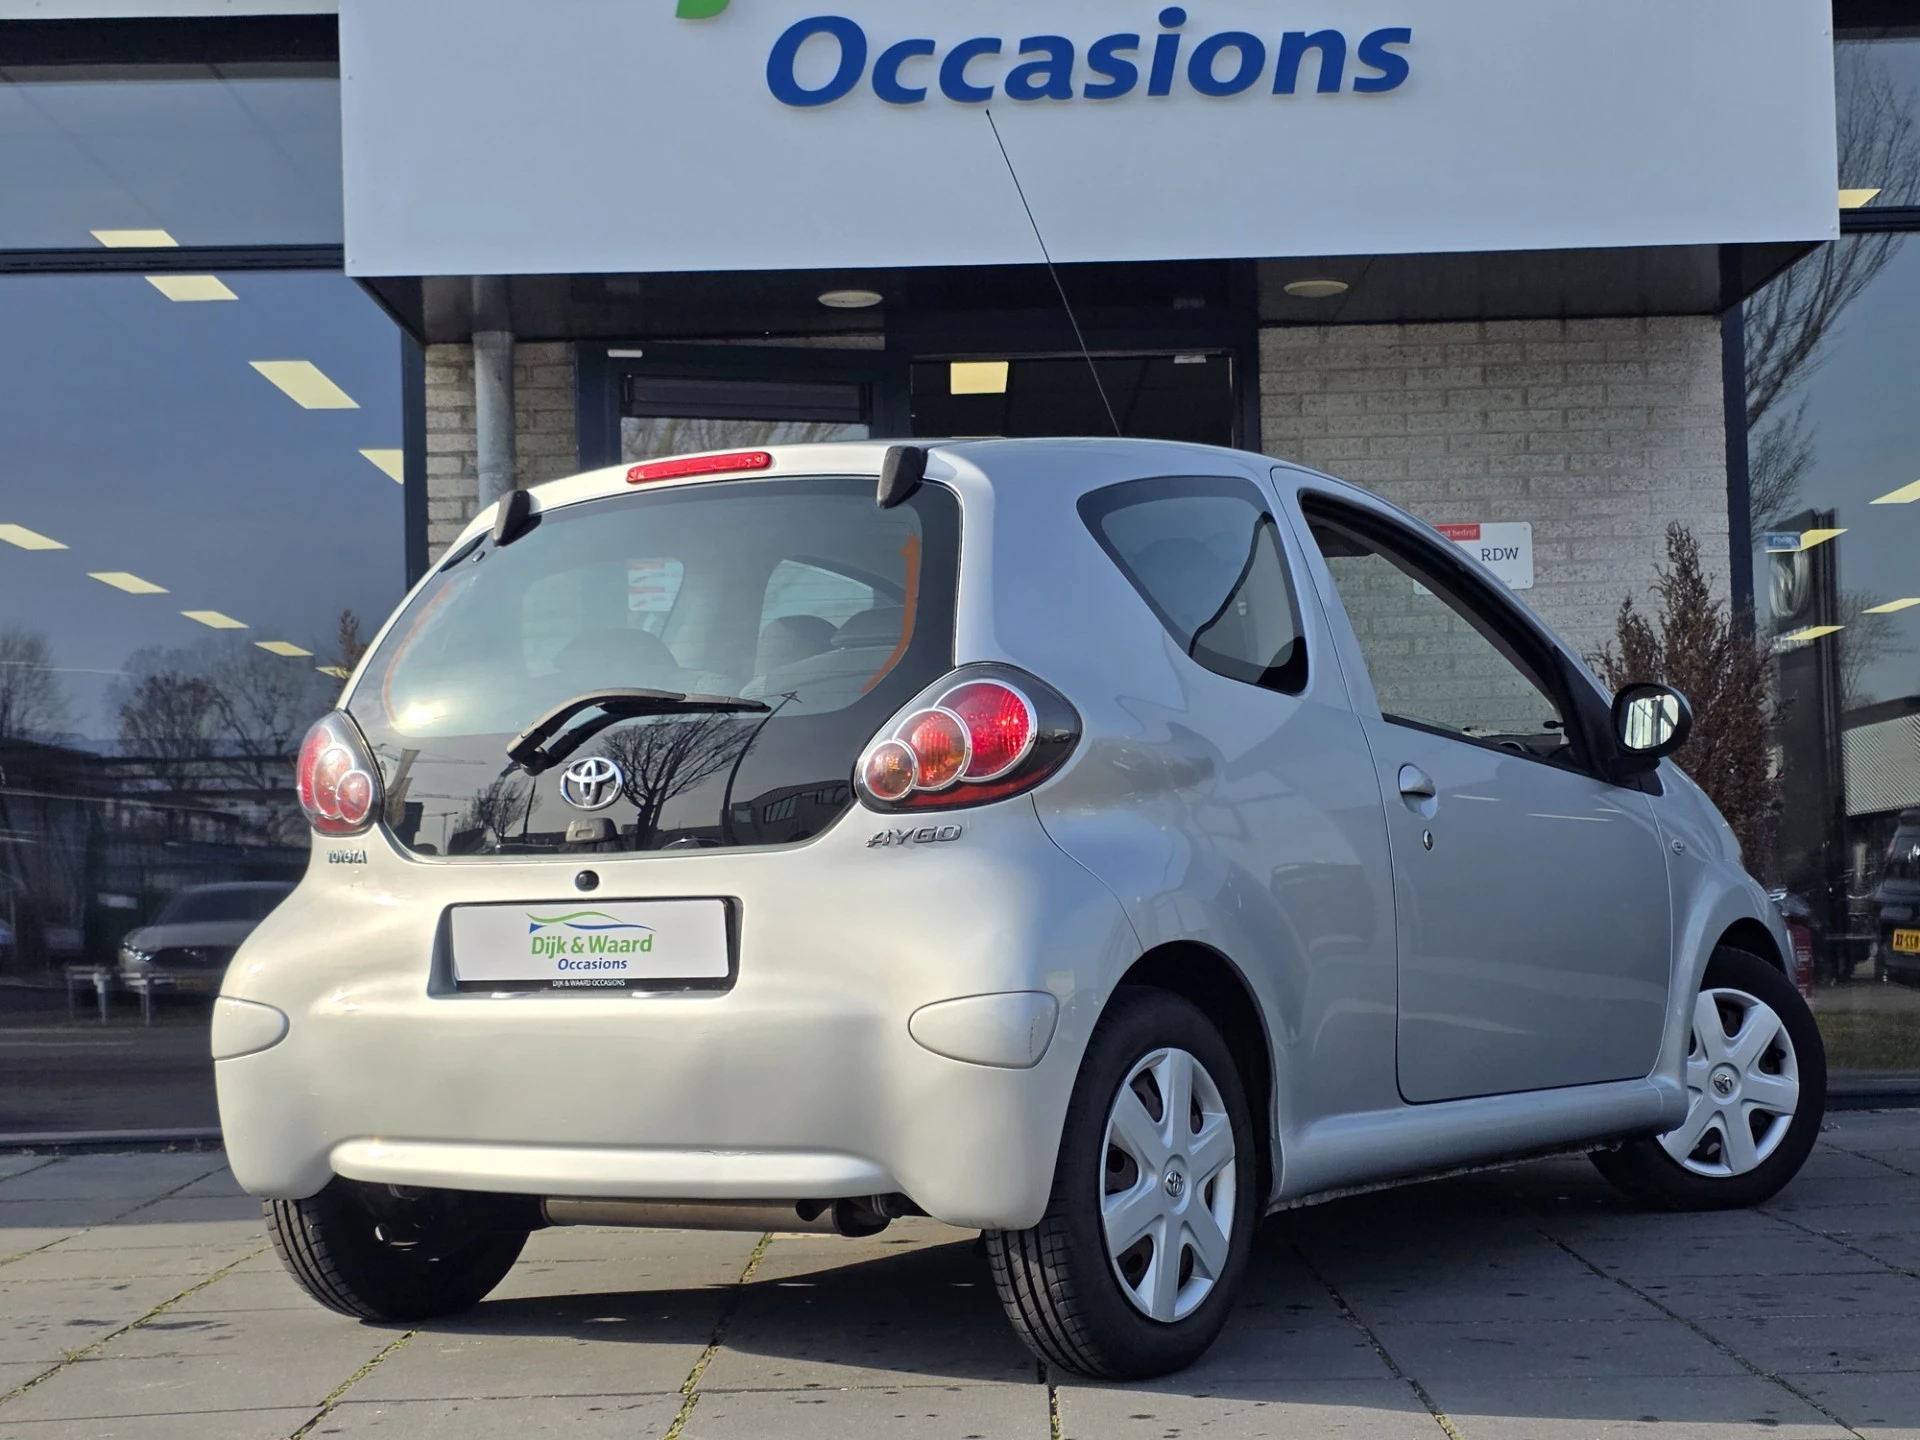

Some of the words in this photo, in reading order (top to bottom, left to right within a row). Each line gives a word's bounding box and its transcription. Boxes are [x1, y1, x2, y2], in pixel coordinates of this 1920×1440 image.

[766, 7, 1412, 107] Occasions
[1481, 547, 1519, 561] RDW
[865, 824, 962, 847] AYGO
[531, 936, 567, 959] Dijk
[570, 936, 584, 953] &
[589, 934, 653, 953] Waard
[557, 957, 627, 971] Occasions
[592, 979, 625, 987] OCCASIONS
